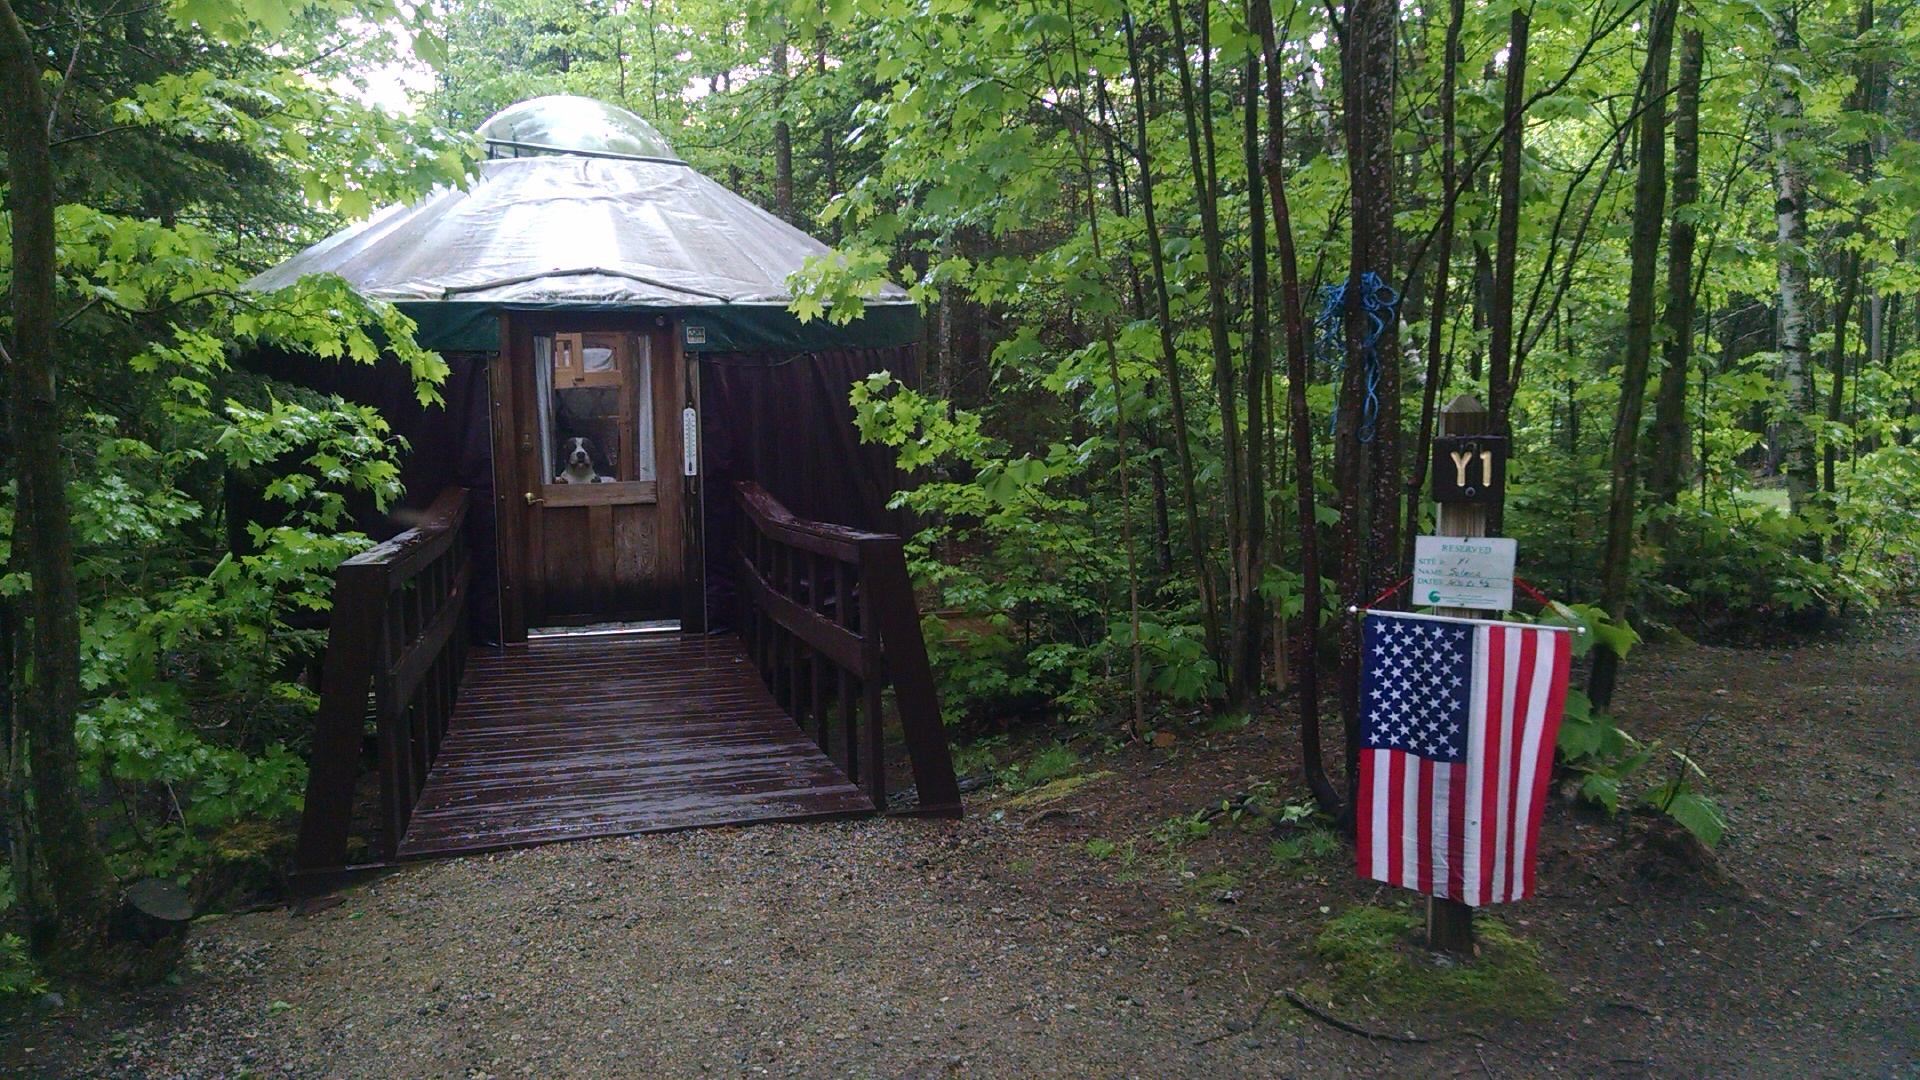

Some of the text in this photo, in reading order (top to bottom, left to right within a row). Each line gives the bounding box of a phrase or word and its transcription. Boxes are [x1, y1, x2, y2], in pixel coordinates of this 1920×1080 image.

[1450, 450, 1492, 487] Y1
[1441, 544, 1492, 555] RESERVED
[1418, 557, 1436, 565] SITE
